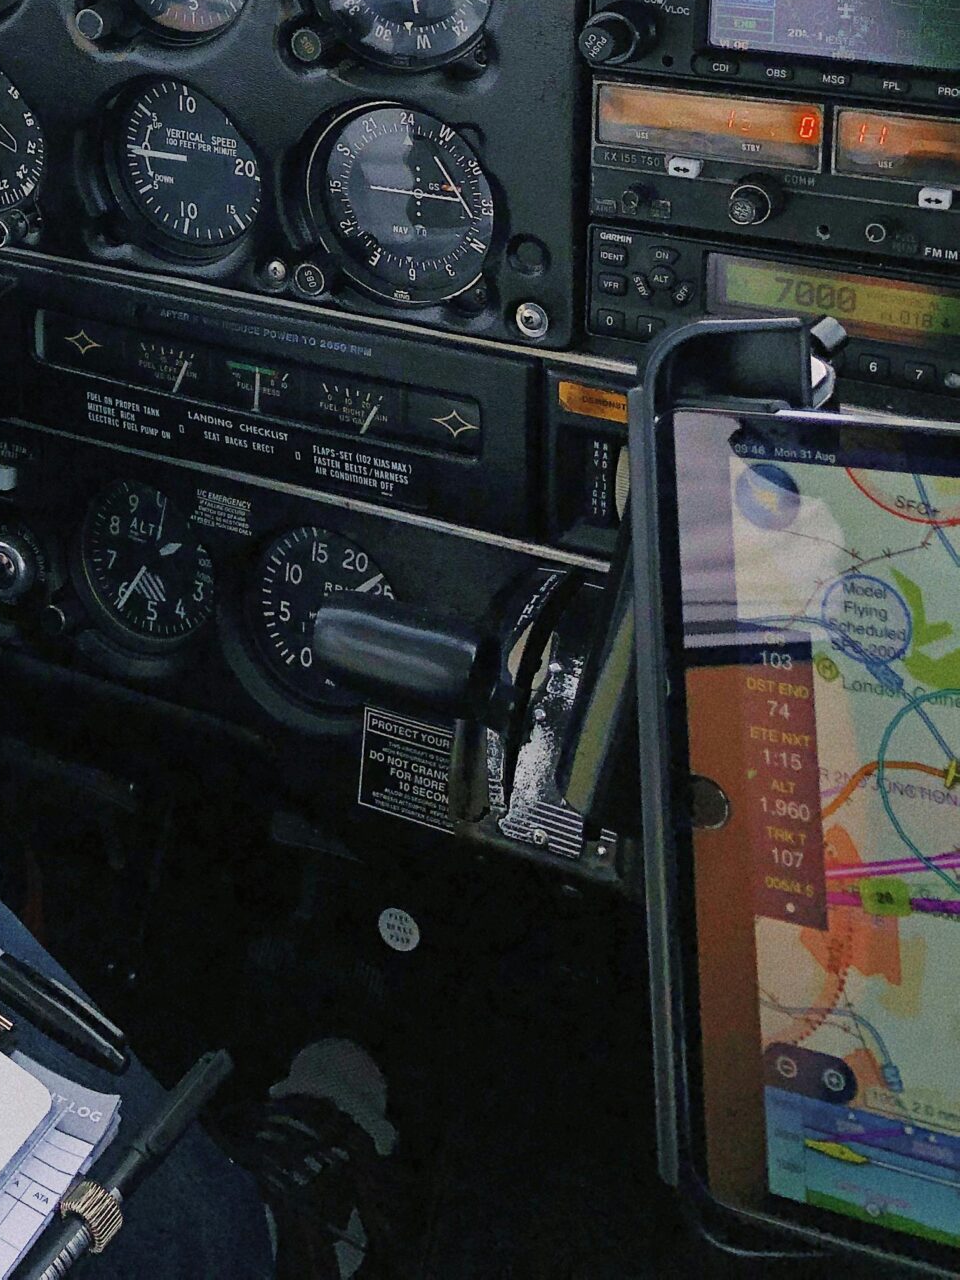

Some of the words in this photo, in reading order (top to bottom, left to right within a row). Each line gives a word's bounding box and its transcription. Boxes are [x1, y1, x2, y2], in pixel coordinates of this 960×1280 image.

[589, 36, 608, 58] PUSH
[712, 63, 729, 72] CDI
[766, 69, 787, 78] OBS
[822, 74, 845, 84] MSG
[883, 81, 900, 91] FPL
[179, 95, 196, 113] 10
[166, 128, 205, 143] VERTICAL
[211, 136, 236, 148] SPEED
[742, 143, 761, 151] STBY
[166, 138, 178, 146] 100
[179, 140, 195, 149] FEET
[198, 143, 212, 152] PER
[214, 146, 237, 157] MINUTE
[604, 152, 617, 161] KX
[235, 159, 255, 177] 20
[154, 174, 174, 184] DOWN
[784, 176, 815, 186] COMM
[181, 201, 197, 219] 10
[600, 232, 632, 244] GARMIN
[600, 251, 624, 261] IDENT
[655, 251, 669, 259] ON
[924, 247, 942, 258] FM
[603, 281, 619, 289] VFR
[633, 276, 649, 297] STBY
[653, 275, 669, 283] ALT
[676, 286, 689, 301] OFF
[775, 276, 856, 313] 7000
[263, 330, 299, 344] POWER
[351, 343, 372, 357] RPM
[86, 392, 102, 403] FUEL
[115, 398, 140, 412] PROPER
[143, 406, 160, 417] TANK
[87, 403, 115, 417] MIXTURE
[120, 410, 135, 421] RICH
[88, 412, 120, 428] ELECTRIC
[123, 421, 139, 432] FUEL
[141, 425, 159, 437] PUMP
[187, 411, 233, 428] LANDING
[239, 423, 289, 442] CHECKLIST
[203, 431, 220, 442] SEAT
[225, 436, 248, 448] BACKS
[252, 442, 275, 454] ERECT
[313, 445, 352, 462] FLAPS-SET
[314, 456, 340, 469] FASTEN
[774, 447, 796, 458] Mon
[799, 449, 812, 459] 31
[815, 451, 836, 464] Aug
[315, 466, 327, 477] AIR
[330, 469, 378, 489] CONDITIONER
[380, 480, 394, 491] OFF
[208, 491, 251, 509] EMERGENCY
[130, 517, 155, 536] ALT
[312, 541, 328, 563] 15
[342, 549, 368, 572] 20
[285, 563, 302, 584] 10
[843, 583, 887, 600] Model
[844, 600, 888, 622] Flying
[830, 619, 906, 642] Scheduled
[760, 650, 792, 670] 103
[746, 677, 777, 694] DST
[779, 681, 809, 699] END
[767, 700, 790, 720] 74
[371, 718, 420, 739] PROTECT
[421, 734, 450, 749] YOUR
[750, 726, 779, 743] ETE
[782, 731, 811, 747] NXT
[369, 750, 385, 762] DO
[387, 756, 409, 769] NOT
[411, 763, 449, 782] CRANK
[763, 748, 802, 771] 1:15
[390, 767, 412, 781] FOR
[414, 774, 446, 792] MORE
[399, 781, 410, 792] 10
[771, 779, 796, 794] ALT
[771, 848, 804, 868] 107
[68, 1102, 103, 1122] LOG
[33, 1192, 49, 1205] ATA
